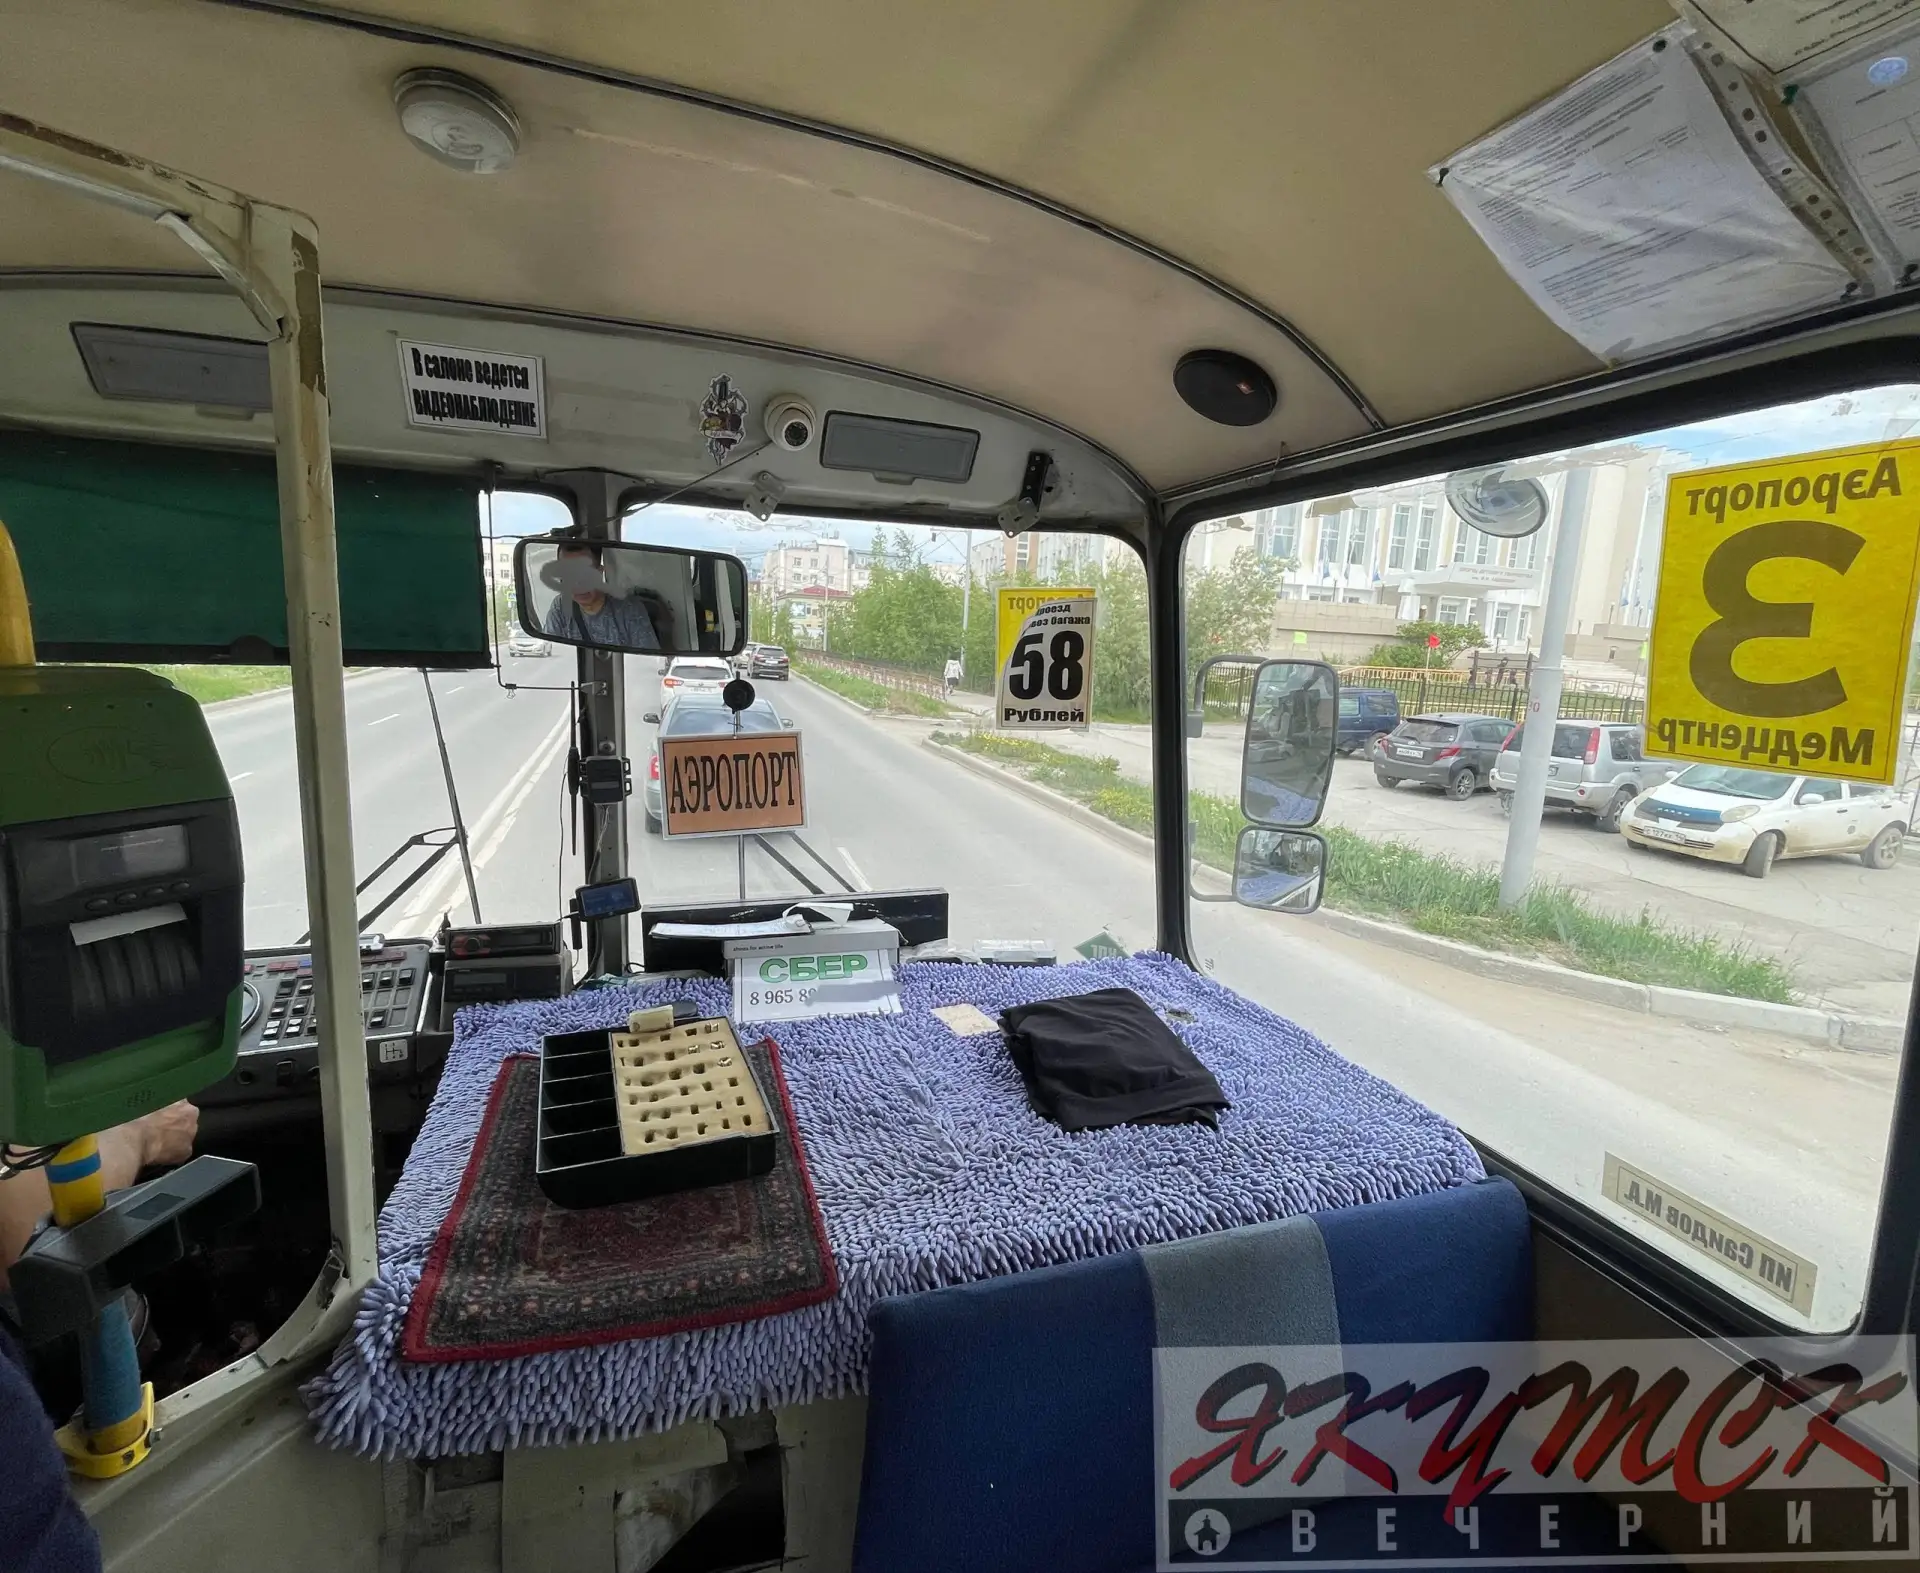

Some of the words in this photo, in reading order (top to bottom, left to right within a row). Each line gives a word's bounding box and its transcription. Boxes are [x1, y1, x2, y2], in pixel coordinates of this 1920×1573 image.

[411, 348, 423, 376] В
[424, 353, 473, 383] салоне
[473, 360, 530, 390] ведется
[412, 388, 537, 428] ВИДЕОНАБЛЮДЕНИЕ
[1030, 618, 1049, 628] воз
[1051, 616, 1091, 625] багажа
[1009, 630, 1085, 700] 58
[1004, 707, 1085, 723] Рублей
[670, 751, 797, 814] АЭРОПОРТ
[759, 954, 868, 983] СБЕР
[750, 991, 760, 1006] 8
[764, 989, 794, 1005] 965
